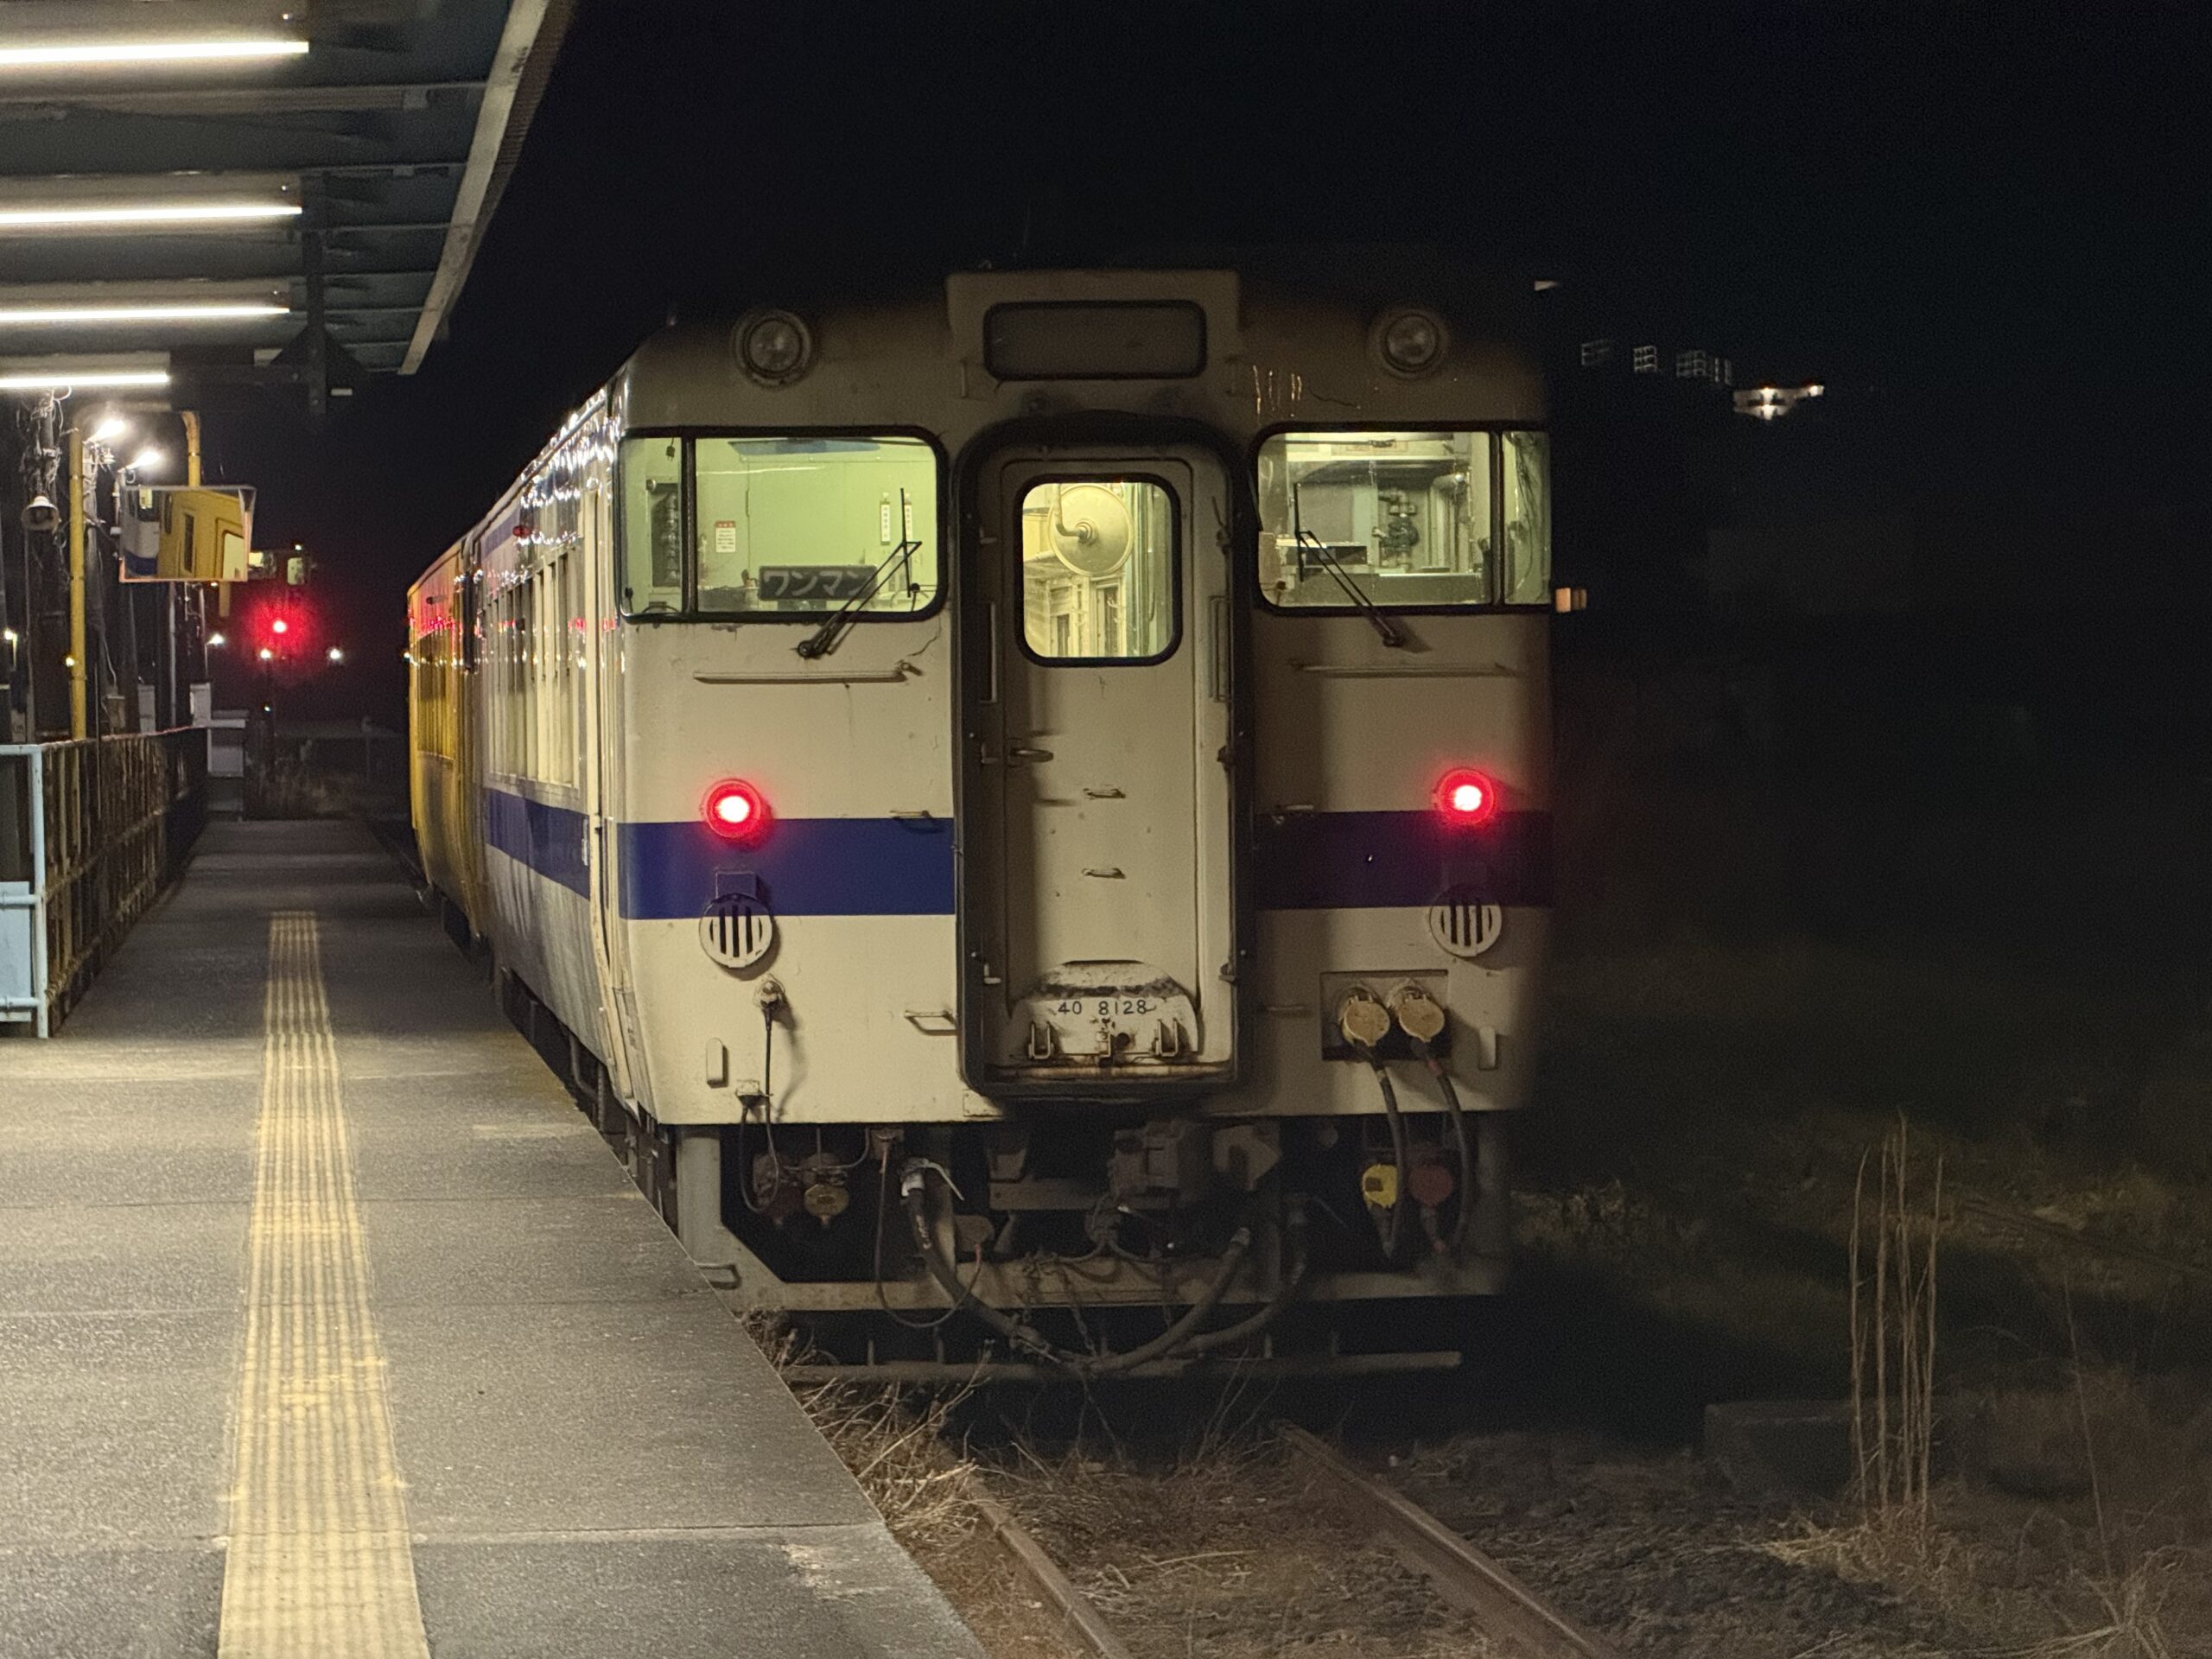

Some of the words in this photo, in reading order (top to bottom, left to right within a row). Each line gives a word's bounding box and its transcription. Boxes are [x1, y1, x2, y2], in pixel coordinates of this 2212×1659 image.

[764, 570, 873, 597] ワンマン
[1058, 1001, 1083, 1015] 40
[1098, 999, 1147, 1015] 8128
